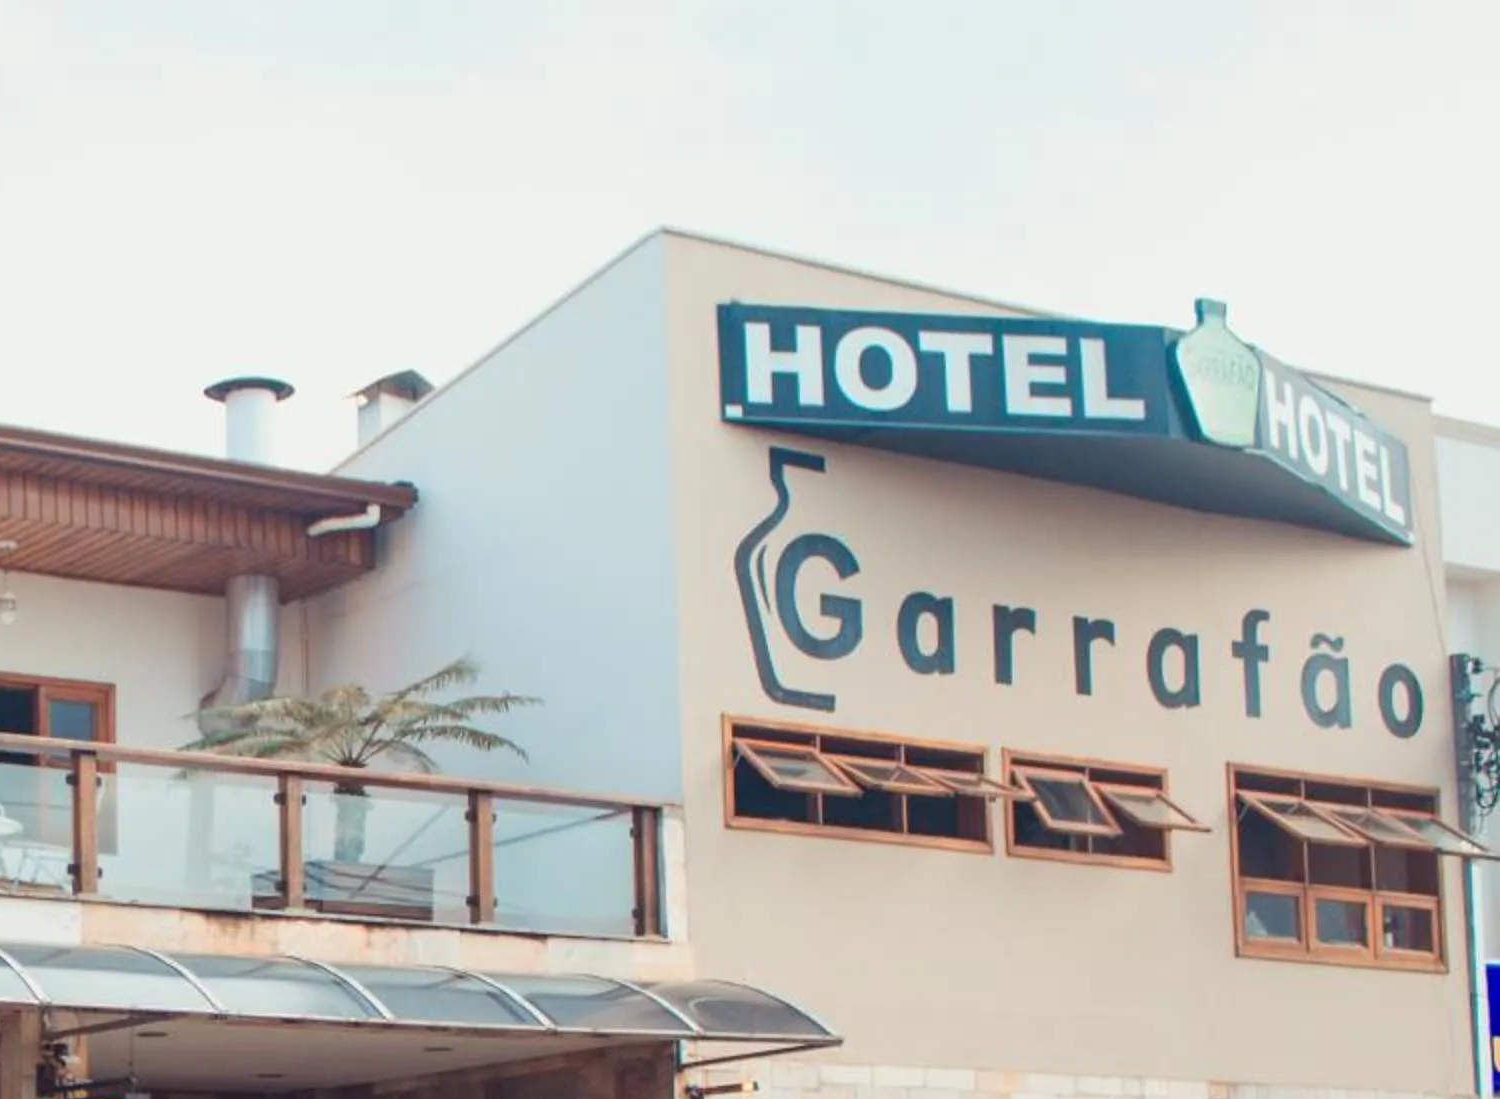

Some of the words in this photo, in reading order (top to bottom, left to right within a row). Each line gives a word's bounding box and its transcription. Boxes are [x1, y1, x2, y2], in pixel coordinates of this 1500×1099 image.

[744, 322, 1146, 420] HOTEL
[1265, 369, 1406, 526] HOTEL
[774, 533, 1424, 739] Garrafão
